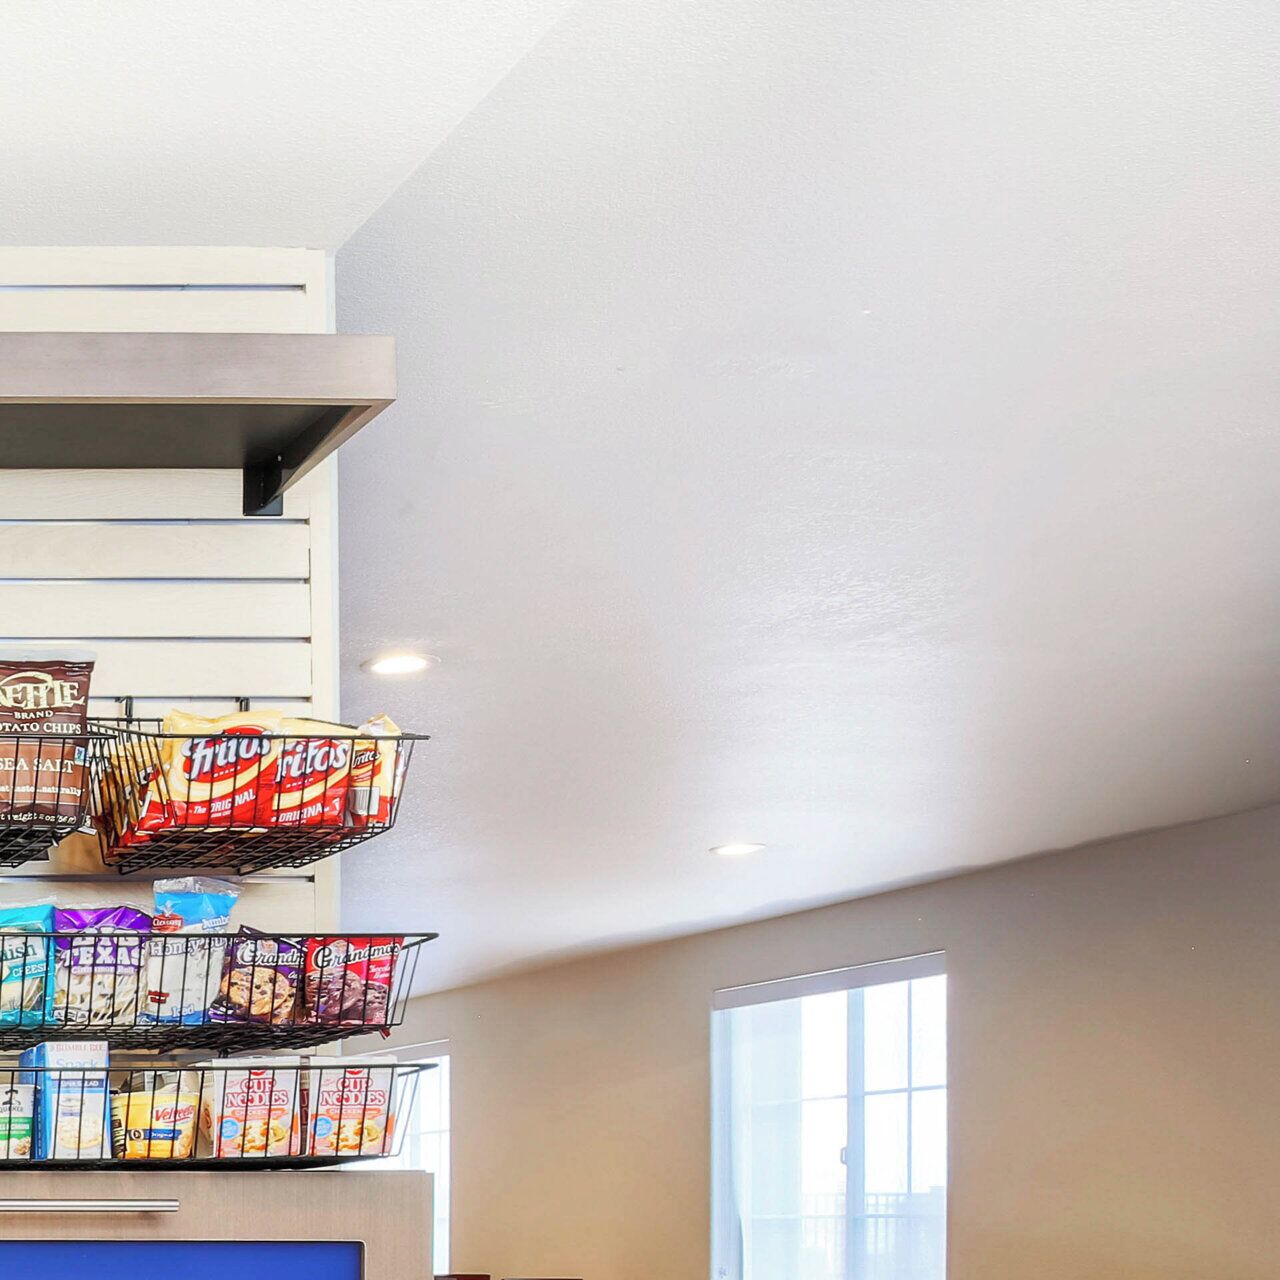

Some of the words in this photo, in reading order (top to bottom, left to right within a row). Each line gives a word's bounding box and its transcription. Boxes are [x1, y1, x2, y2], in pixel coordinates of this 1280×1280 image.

[14, 710, 54, 719] BRAND
[43, 722, 82, 734] CHIPS
[33, 758, 75, 774] SALT
[150, 938, 200, 957] Honey
[241, 1078, 276, 1093] CUP
[336, 1078, 373, 1093] CUP
[226, 1090, 290, 1108] NOODLES
[321, 1090, 388, 1108] NOODLES
